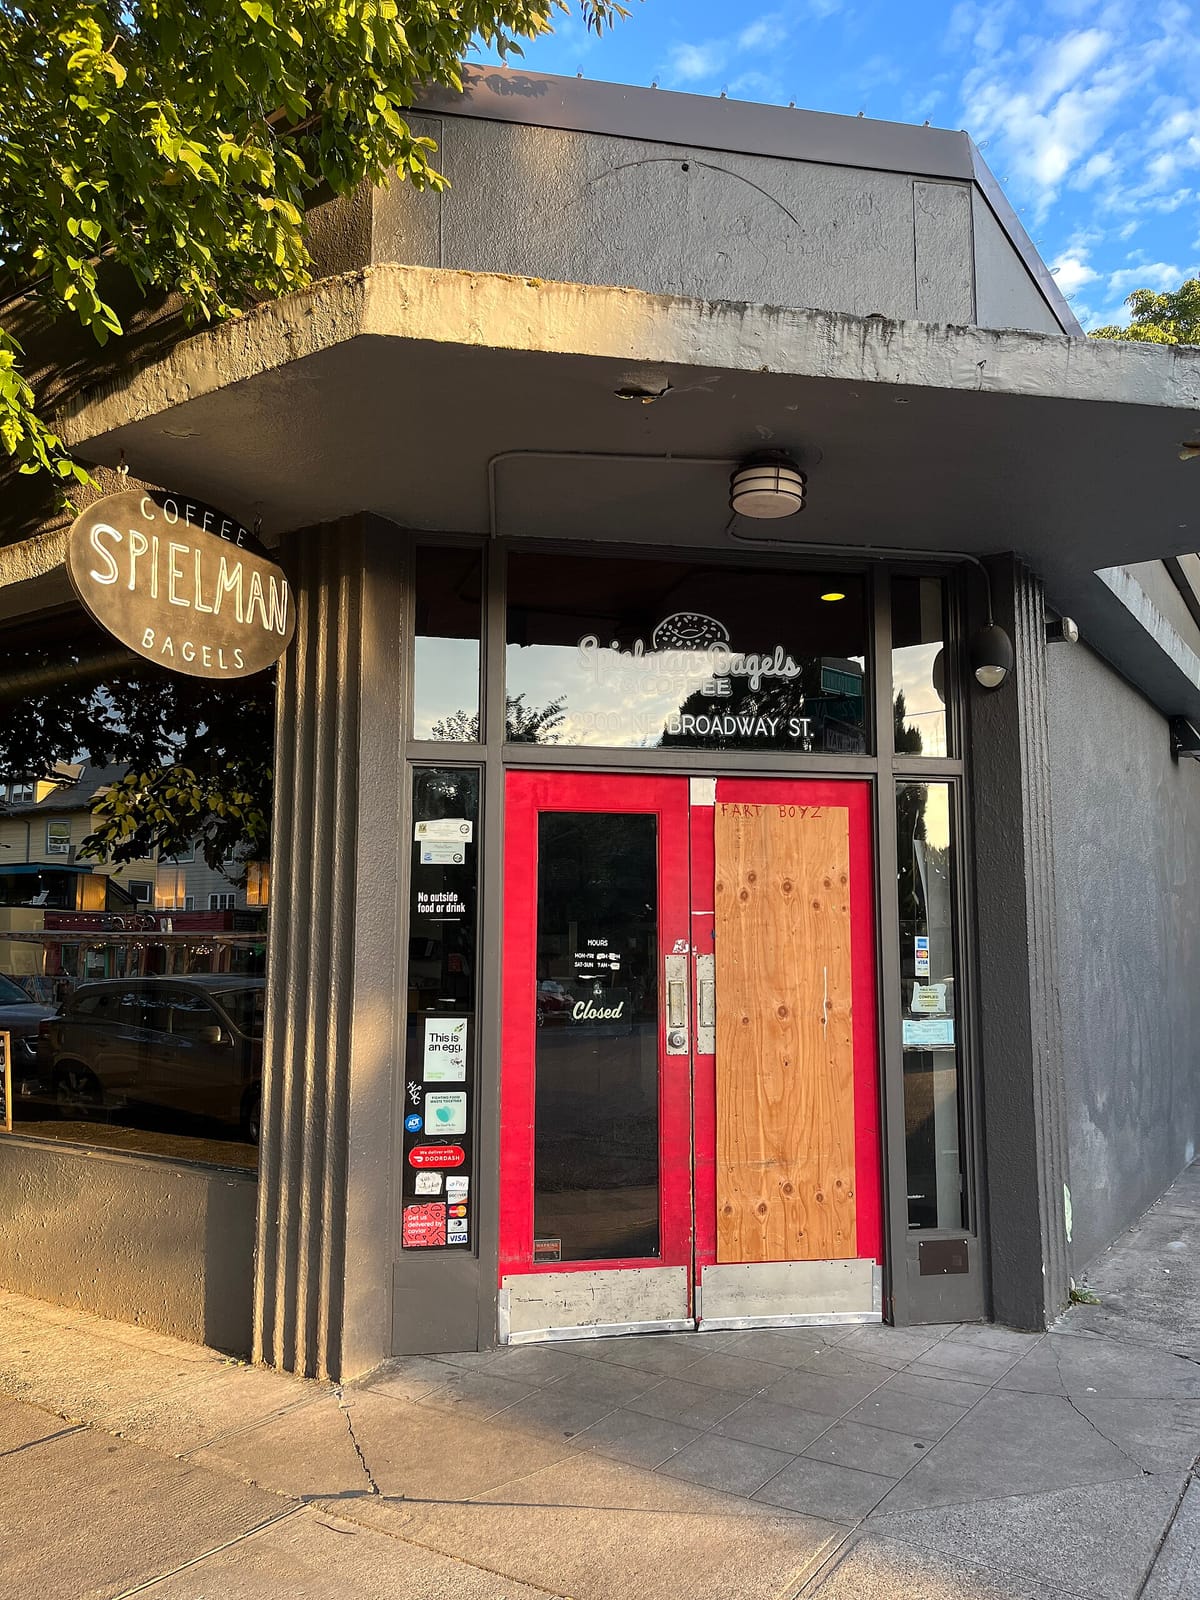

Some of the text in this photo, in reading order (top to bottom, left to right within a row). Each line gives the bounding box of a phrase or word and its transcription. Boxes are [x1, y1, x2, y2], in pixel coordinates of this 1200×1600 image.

[140, 496, 248, 548] COFFEE
[90, 523, 288, 636] SPIELMAN
[141, 627, 244, 670] BAGELS
[708, 641, 802, 691] Bagels
[667, 715, 779, 737] BROADWAY
[789, 718, 815, 737] ST.
[721, 804, 822, 819] FART BOYZ
[418, 891, 458, 903] No outside
[417, 902, 466, 913] food or drink
[587, 939, 609, 947] HOURS
[572, 1000, 625, 1020] Closed
[428, 1032, 459, 1043] This is
[428, 1043, 463, 1054] an egg.
[408, 1118, 420, 1127] ADT
[450, 1234, 467, 1242] VISA
